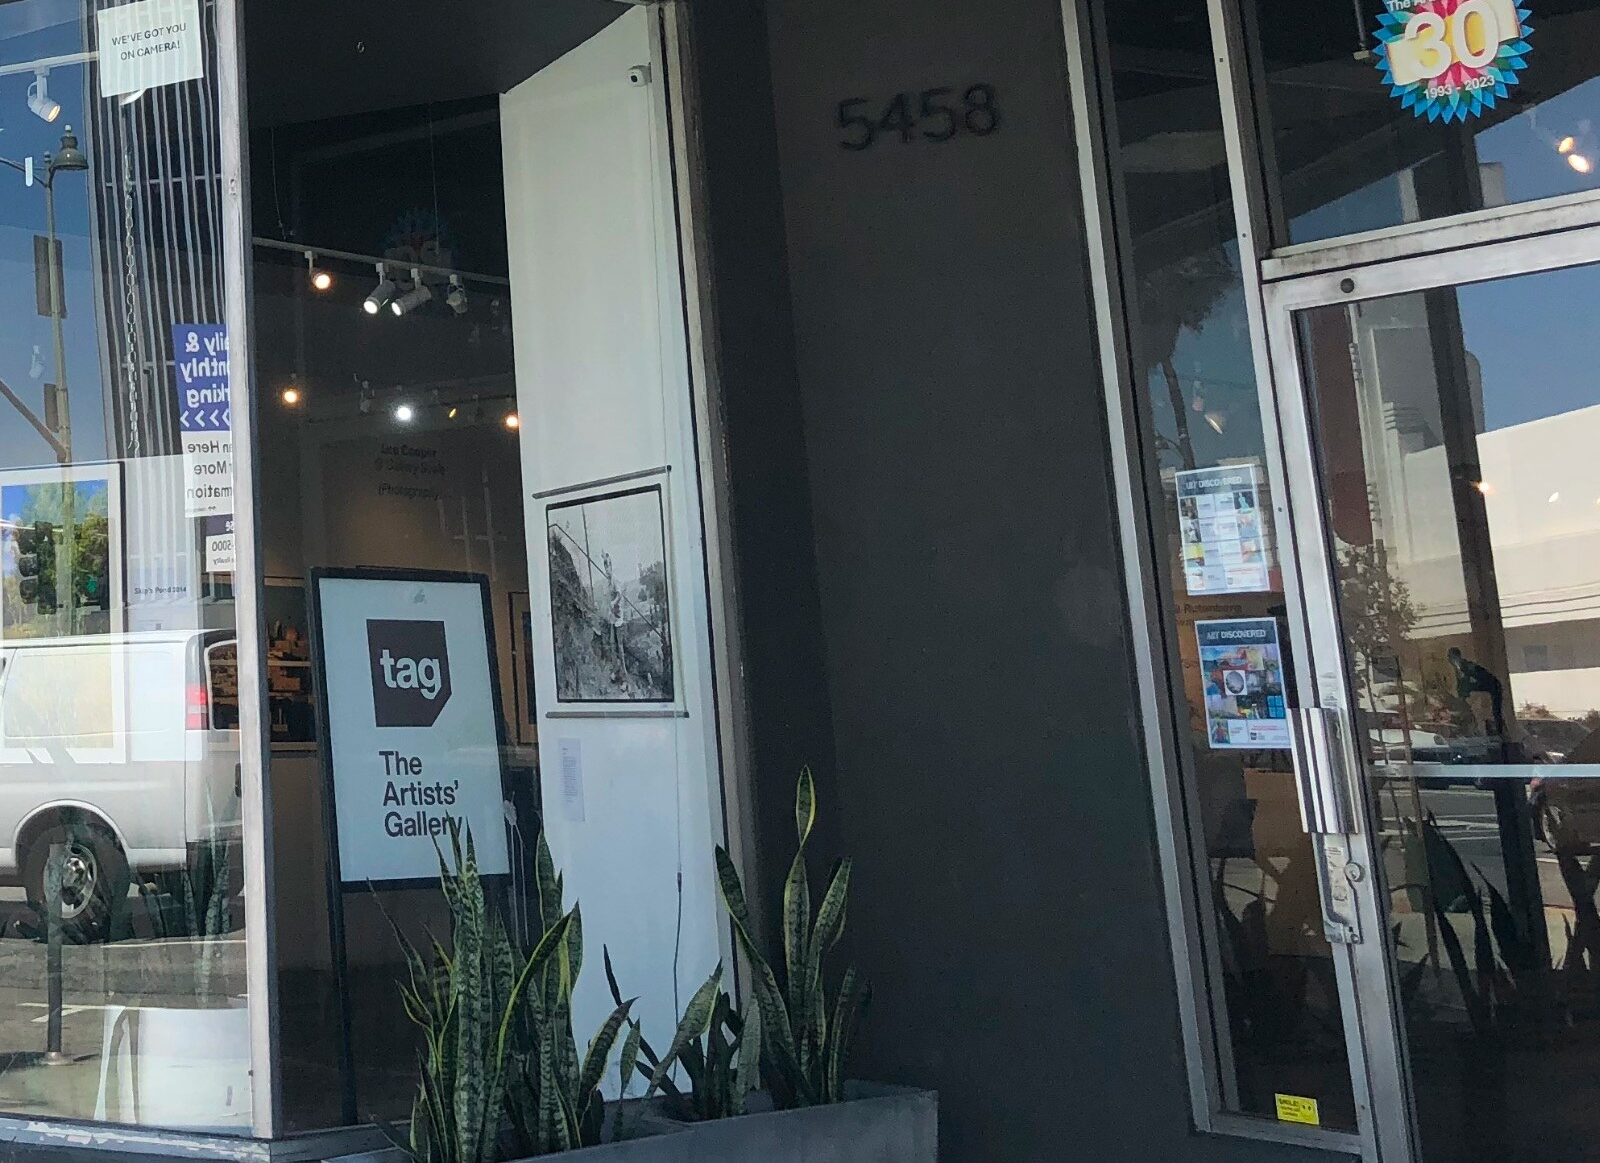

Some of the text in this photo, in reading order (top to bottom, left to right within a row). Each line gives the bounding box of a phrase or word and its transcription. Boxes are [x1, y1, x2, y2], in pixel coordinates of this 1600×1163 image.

[112, 22, 187, 46] WE'VE GOT YOU
[120, 40, 181, 61] ON CAMERA!
[1424, 86, 1453, 100] 1993
[1465, 75, 1496, 92] 2023
[833, 82, 1002, 152] 5458
[379, 649, 442, 700] tag
[378, 751, 422, 776] The
[383, 779, 459, 807] Artists'
